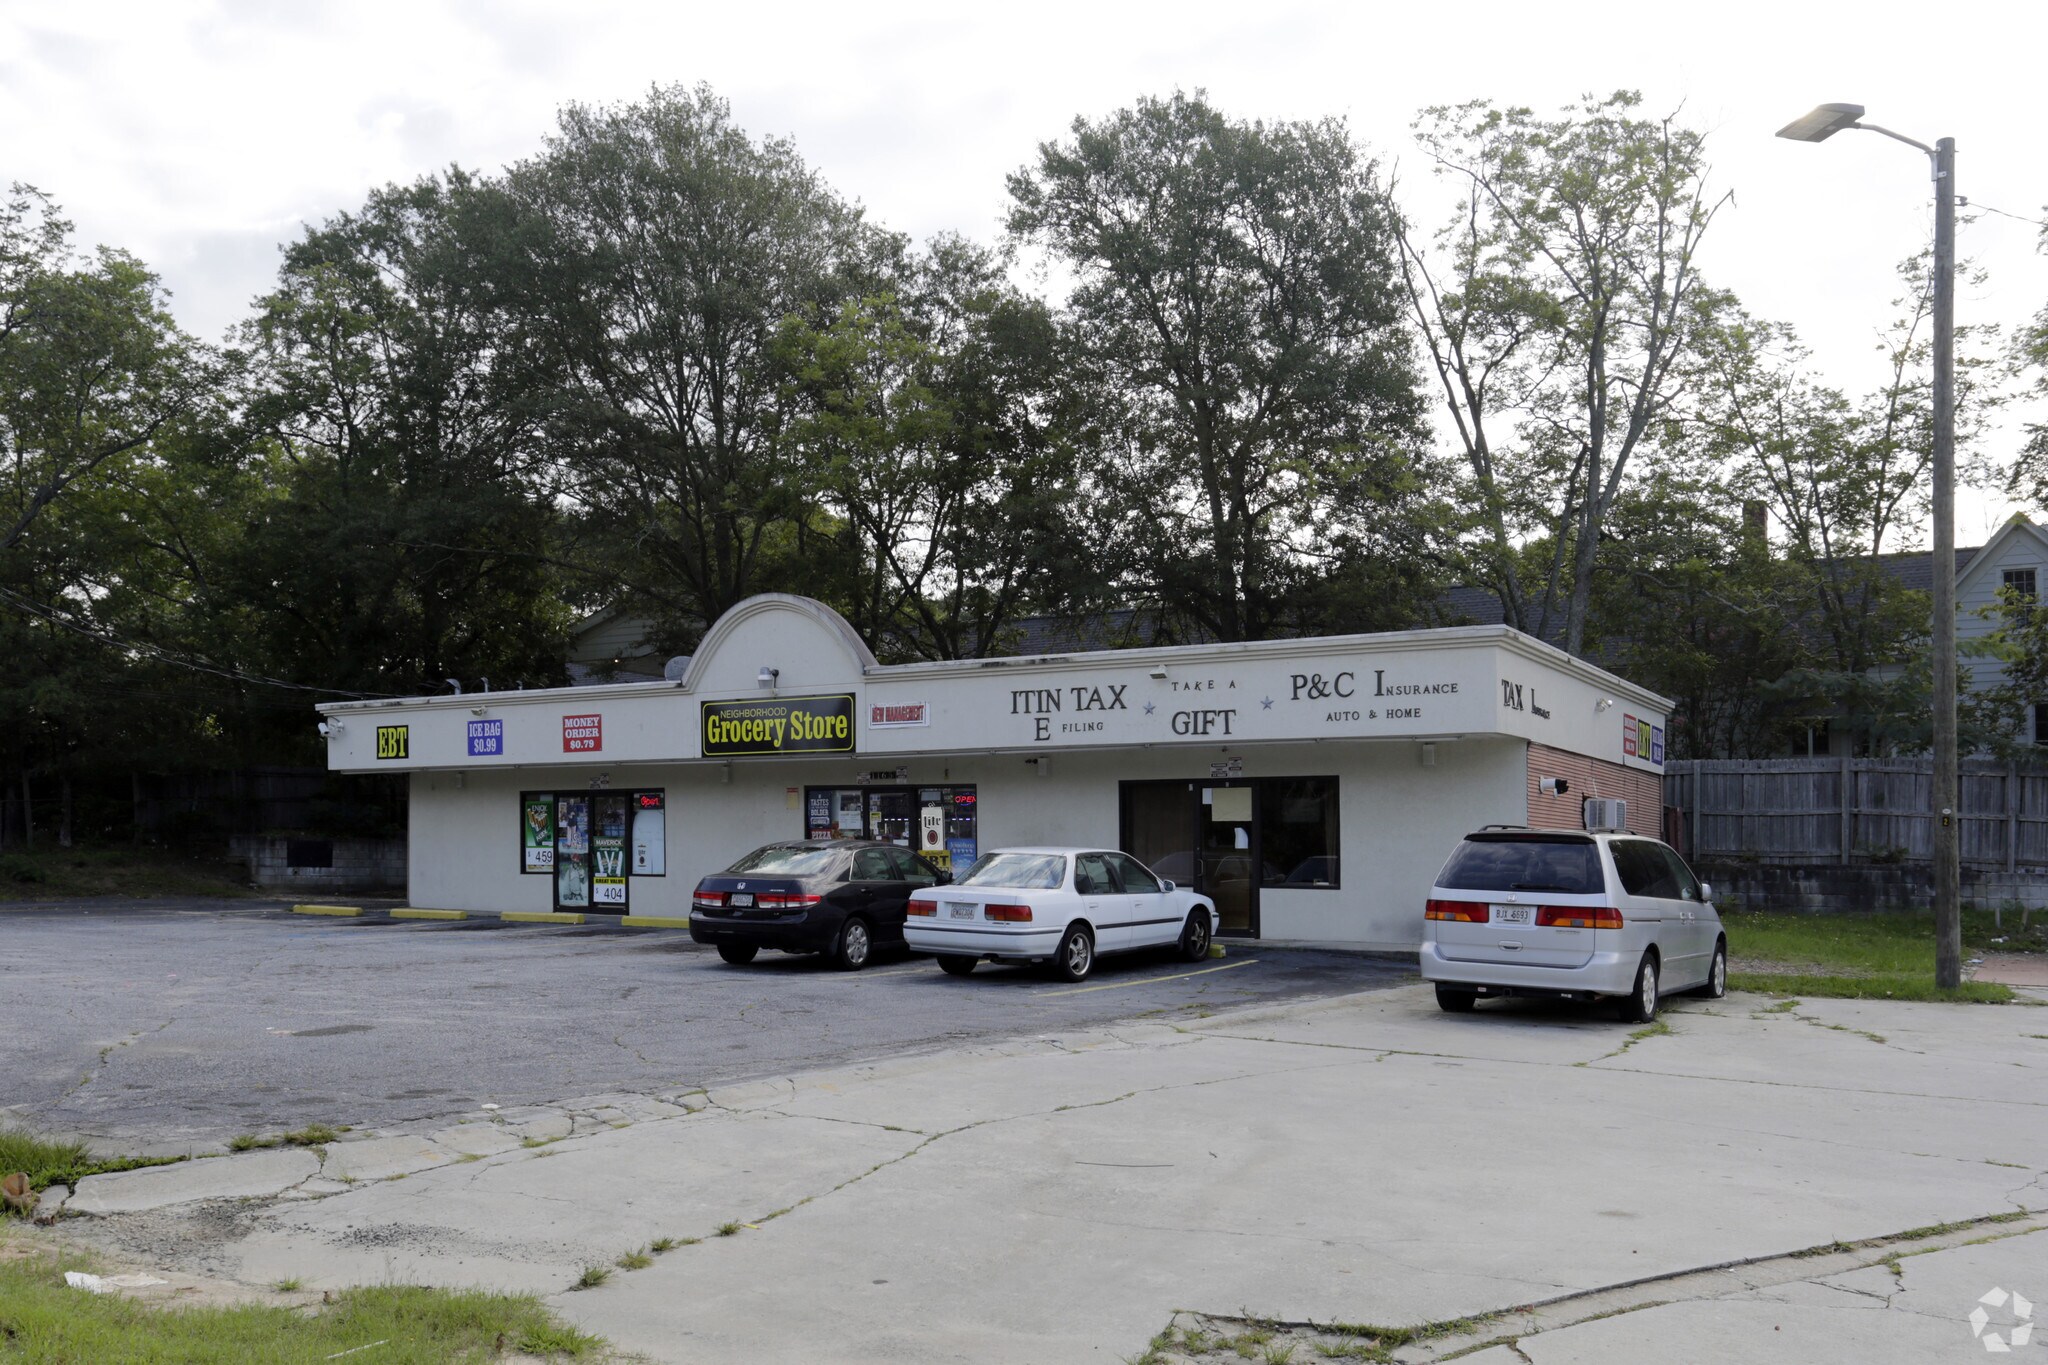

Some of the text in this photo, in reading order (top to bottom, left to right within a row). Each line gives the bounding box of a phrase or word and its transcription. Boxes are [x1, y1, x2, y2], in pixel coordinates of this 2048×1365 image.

[1172, 680, 1236, 691] TAKE A
[1290, 671, 1355, 700] P&C
[1010, 684, 1128, 714] ITIN TAX
[1501, 678, 1524, 711] TAX
[720, 707, 787, 719] NEIGHBORHOOD
[1326, 708, 1421, 722] AUTO & HOME
[469, 721, 501, 737] ICE BAG
[564, 717, 599, 728] MONEY
[708, 711, 848, 747] Grocery Store
[1034, 717, 1104, 741] E FILING
[1171, 709, 1237, 736] GIFT
[564, 727, 599, 738] ORDER
[378, 727, 407, 757] EBT
[474, 738, 496, 752] $0.99
[570, 740, 595, 750] $0.79
[535, 851, 552, 863] 459
[922, 855, 949, 866] BT
[604, 888, 622, 900] 404
